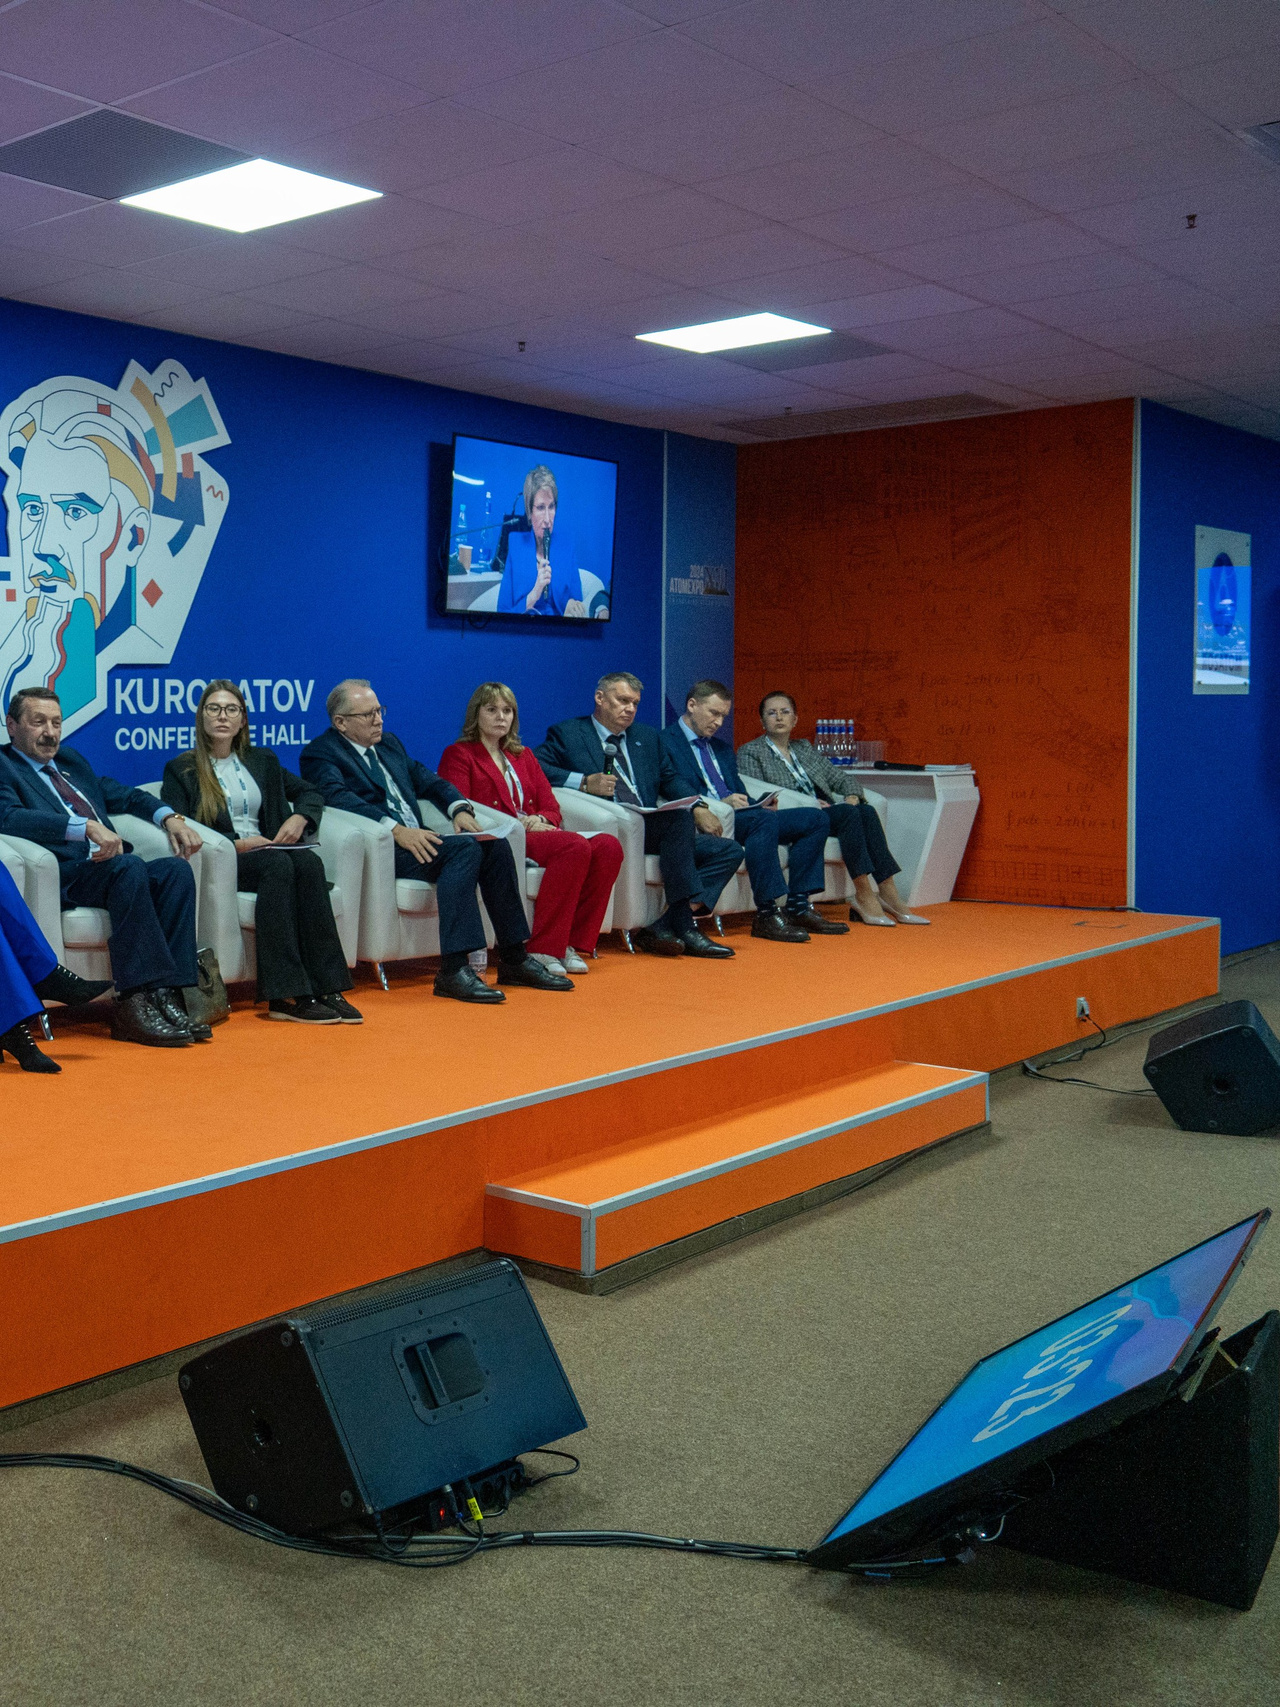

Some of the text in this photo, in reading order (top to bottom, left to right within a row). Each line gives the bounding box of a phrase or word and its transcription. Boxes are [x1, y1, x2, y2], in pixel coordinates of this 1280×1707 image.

[114, 677, 315, 715] KURCATOV
[114, 723, 312, 751] CONFEE HALL
